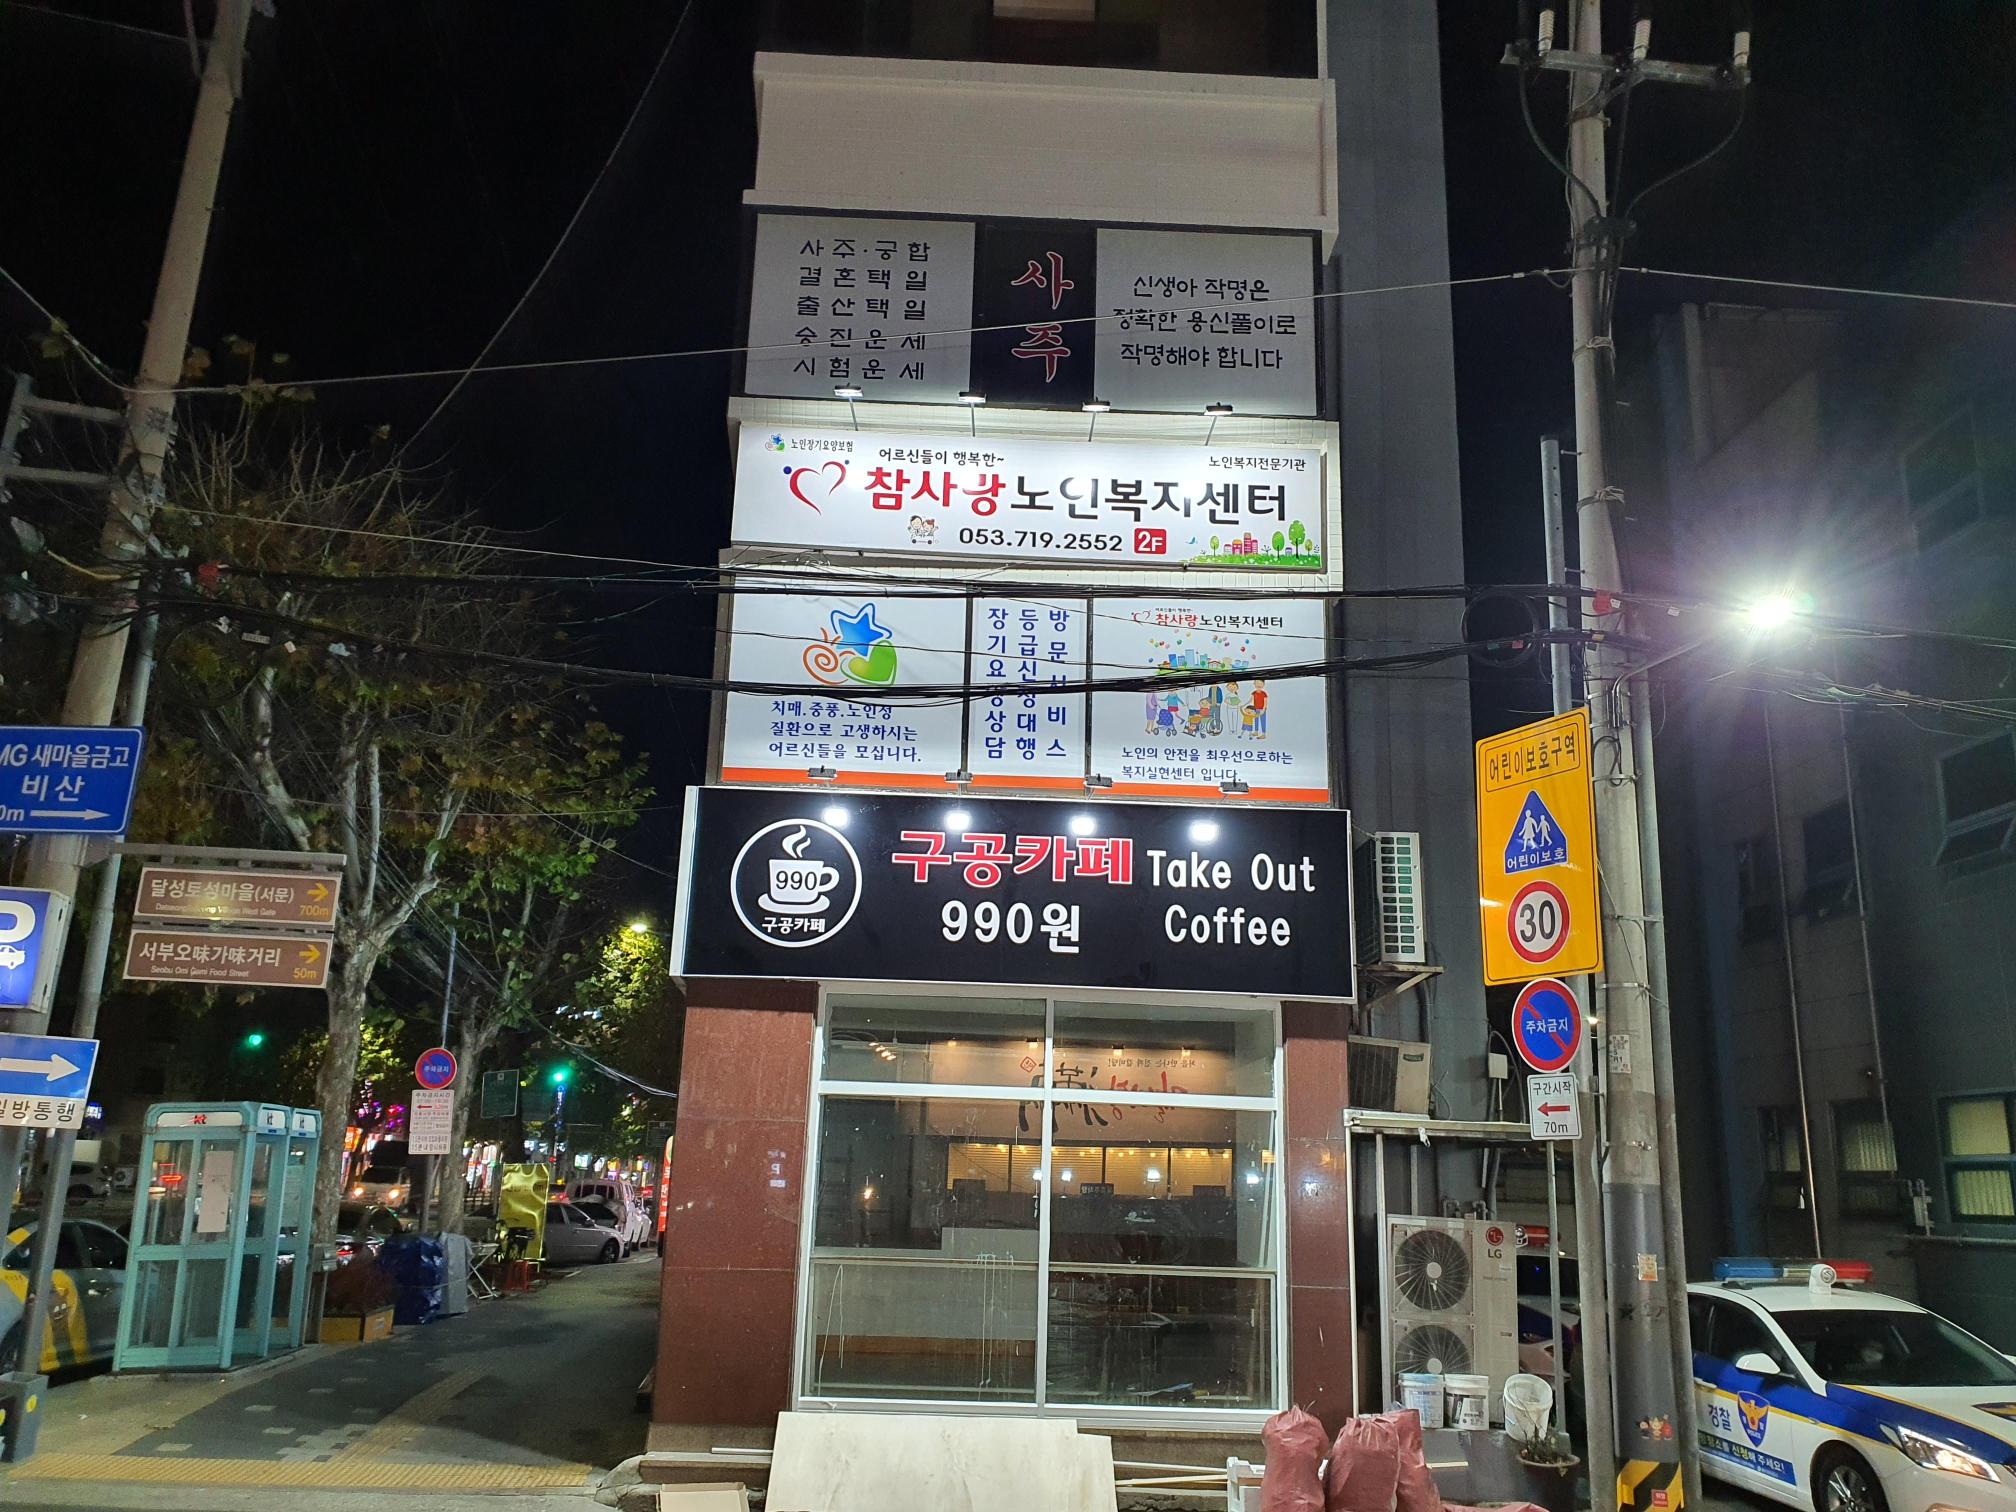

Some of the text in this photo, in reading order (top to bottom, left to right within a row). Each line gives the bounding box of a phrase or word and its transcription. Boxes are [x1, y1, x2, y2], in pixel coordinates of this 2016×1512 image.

[1132, 274, 1271, 302] 신생아 작명은
[1010, 250, 1075, 384] 사주
[1112, 308, 1298, 338] 정확한 용신풀이로
[1119, 342, 1284, 371] 작명해야 합니다
[790, 438, 854, 453] 노인장기요양보험
[878, 447, 948, 465] 어르신들이
[1207, 455, 1306, 472] 노인복지전문기관
[863, 466, 1287, 525] 참사랑 노인복지센터
[958, 526, 1165, 553] 053.719.2552 2F
[1155, 613, 1284, 630] 참사랑 노인복지센터
[770, 720, 918, 742] 질환으로 고생하시는
[31, 743, 130, 769] 새마을금고
[768, 741, 922, 763] 어르신들을 모십니다.
[1121, 746, 1294, 765] 노인의 안전을 최우선으로하는
[1488, 730, 1577, 784] 어린이보호구역
[1121, 765, 1196, 780] 복지실현센터
[890, 828, 1316, 894] 구공카페 Take Out
[1506, 847, 1566, 870] 어린이보호
[150, 878, 295, 904] 달성토성마을(서문)
[774, 869, 818, 893] 990
[300, 904, 329, 918] 700m
[1518, 899, 1556, 943] 30
[760, 915, 827, 936] 구공카페
[940, 898, 1292, 955] 990원 Coffee
[138, 941, 282, 968] 서부오味가味거리
[291, 967, 317, 980] 50m
[1525, 1016, 1569, 1035] 주차금지
[1532, 1080, 1572, 1097] 구간시작
[1543, 1121, 1569, 1134] 70m
[1487, 1248, 1503, 1259] LG
[1707, 1403, 1733, 1432] 경찰
